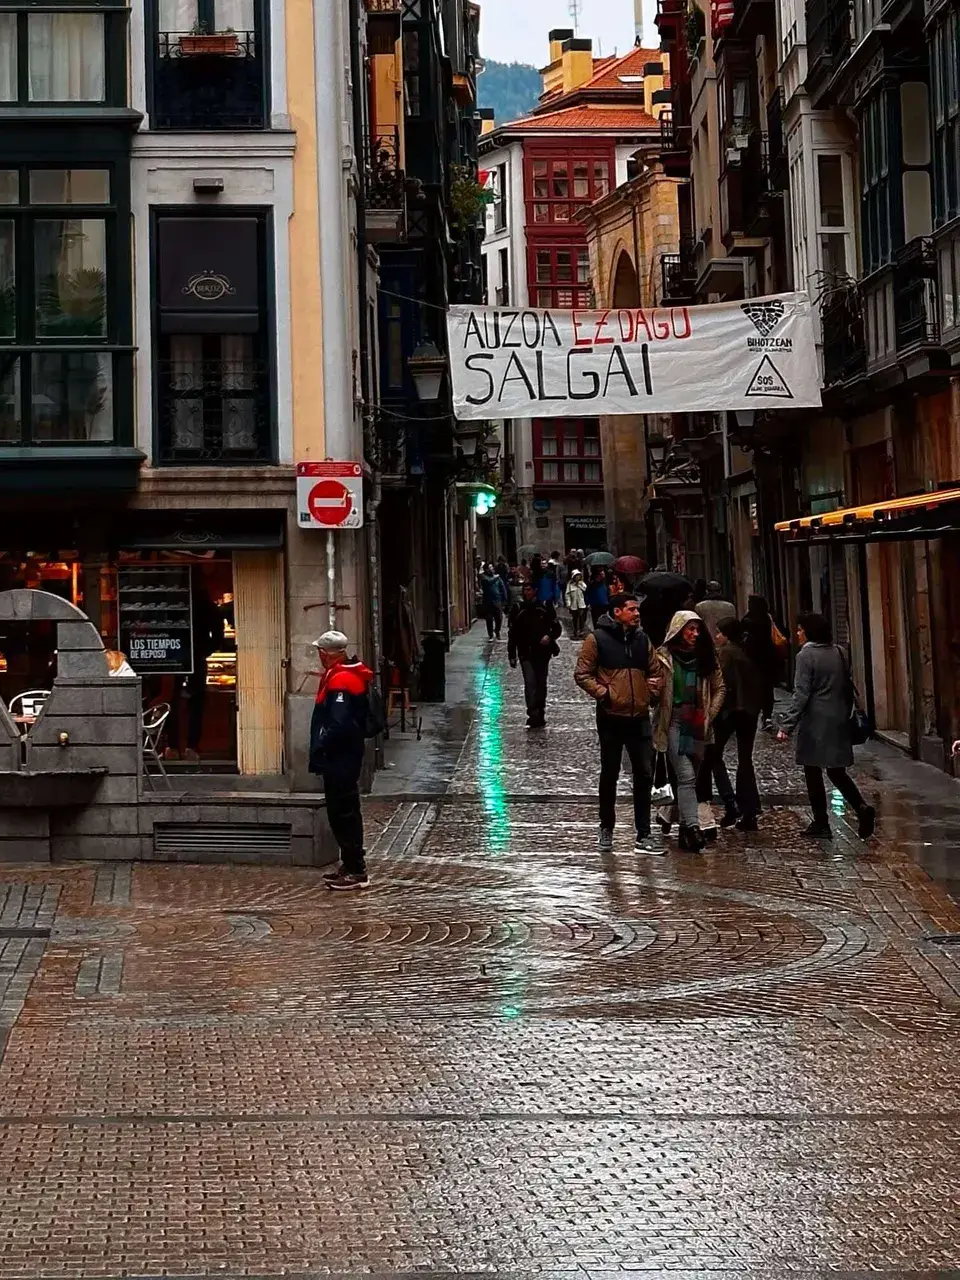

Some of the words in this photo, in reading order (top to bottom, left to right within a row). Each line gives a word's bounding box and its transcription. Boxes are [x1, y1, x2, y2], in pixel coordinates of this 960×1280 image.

[463, 310, 563, 350] AUZOA
[572, 309, 615, 346] EZ
[746, 336, 793, 348] BIHOTZEAN
[464, 342, 654, 406] SALGAI
[757, 375, 774, 386] SOS
[130, 639, 145, 650] LOS
[146, 638, 181, 650] TIEMPOS
[130, 650, 139, 659] DE
[140, 649, 167, 659] REPOSO
